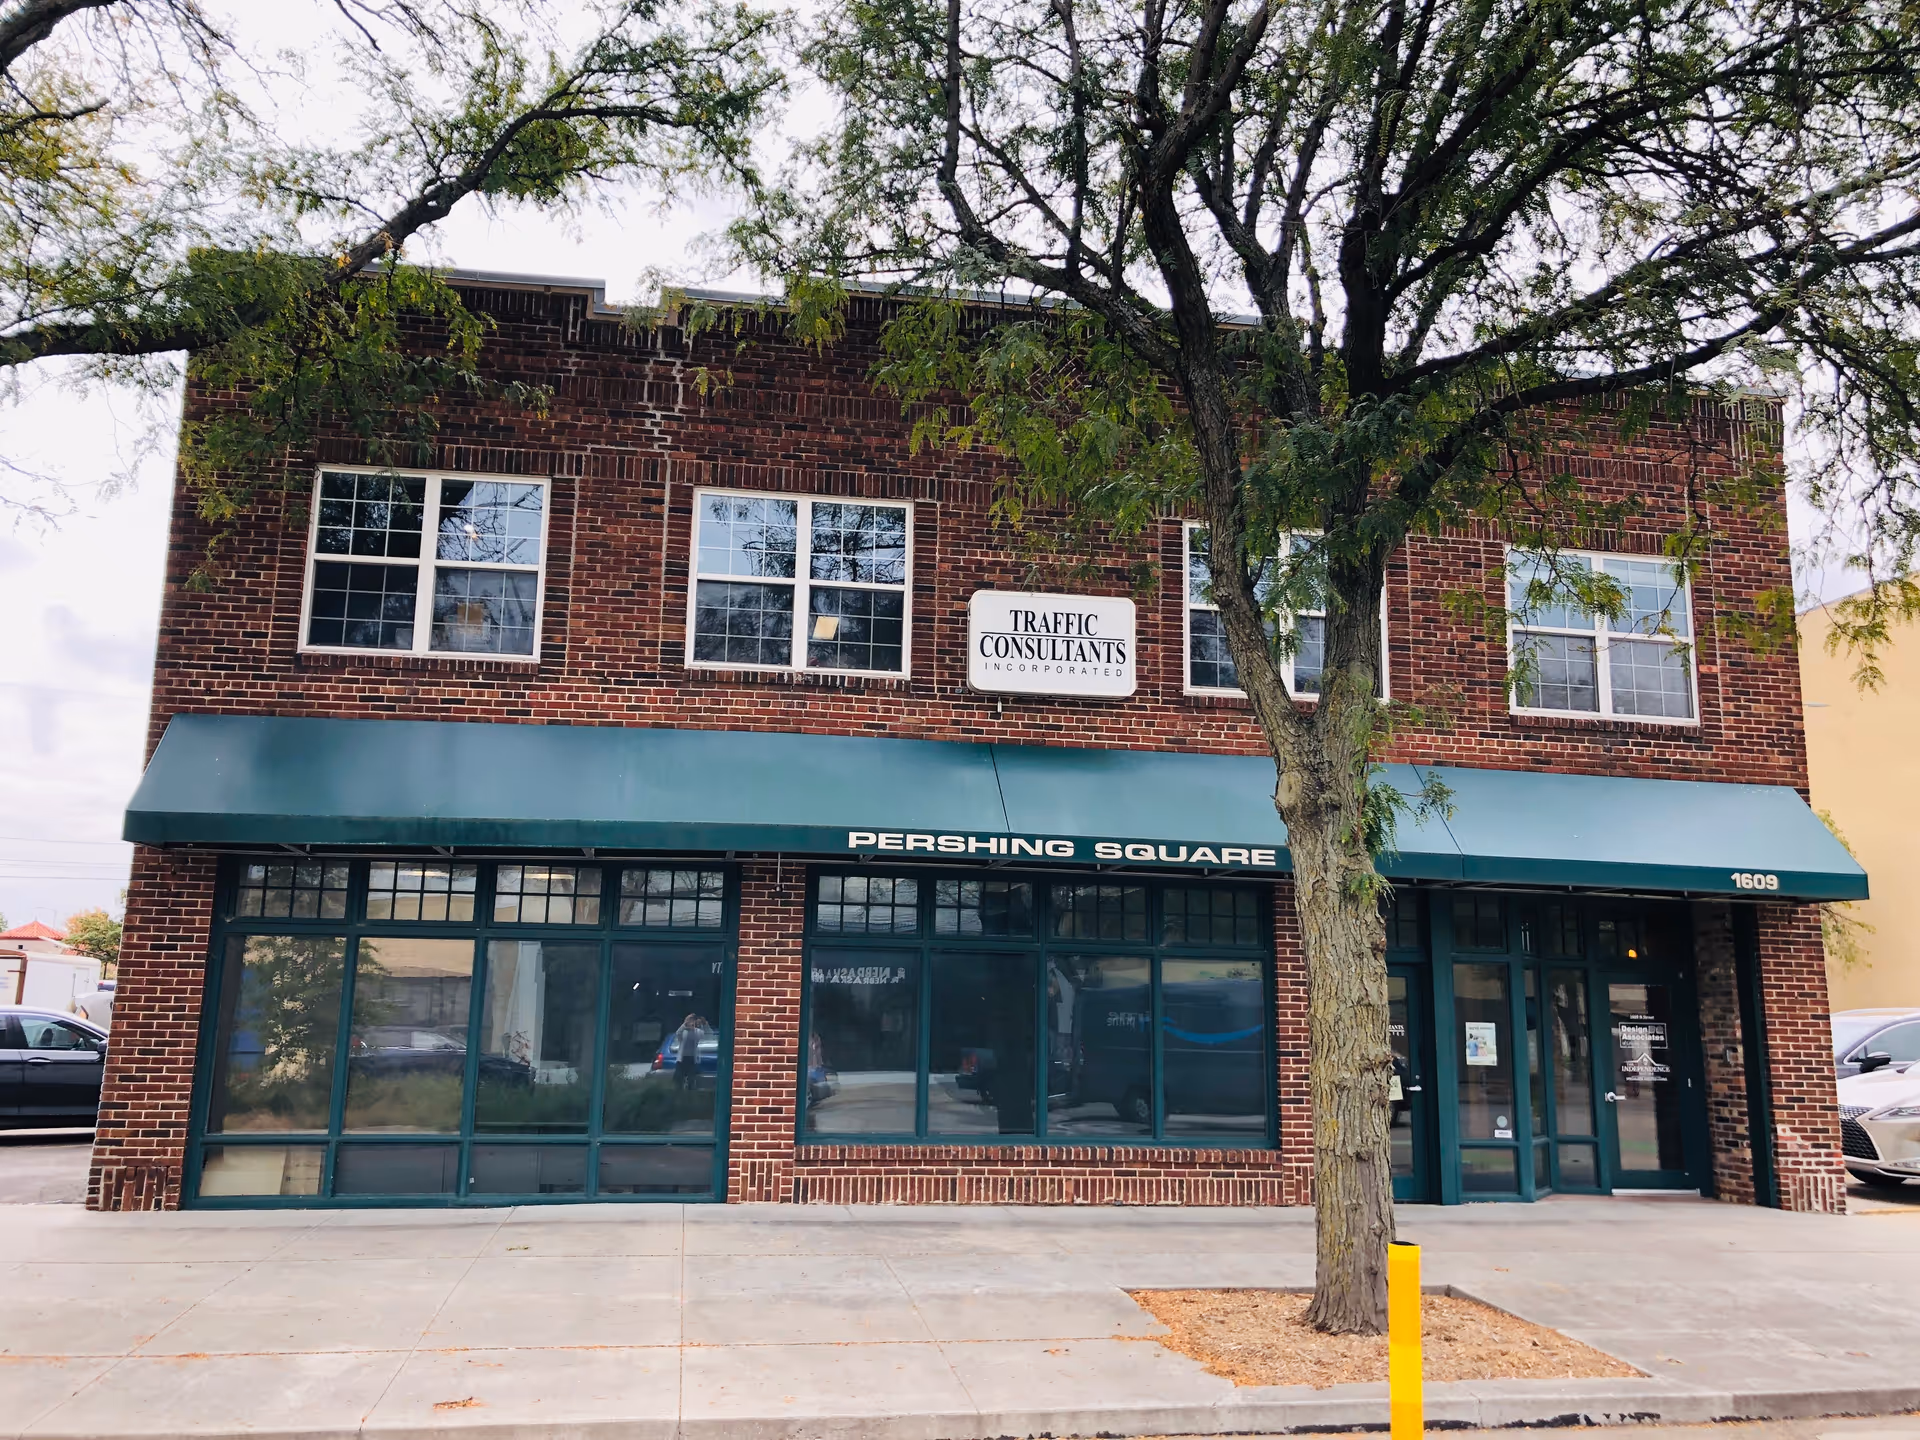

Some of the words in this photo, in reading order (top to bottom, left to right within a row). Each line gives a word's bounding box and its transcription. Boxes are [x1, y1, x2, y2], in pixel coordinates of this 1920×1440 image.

[1009, 609, 1098, 636] TRAFFIC
[980, 635, 1126, 664] CONSULTANTS
[984, 662, 1123, 677] INCORPORATED
[848, 831, 1074, 857] PERSHING
[1095, 842, 1276, 866] SQUARE
[1731, 872, 1778, 890] 1609
[1621, 1025, 1648, 1033] Design
[1621, 1033, 1665, 1041] Associates
